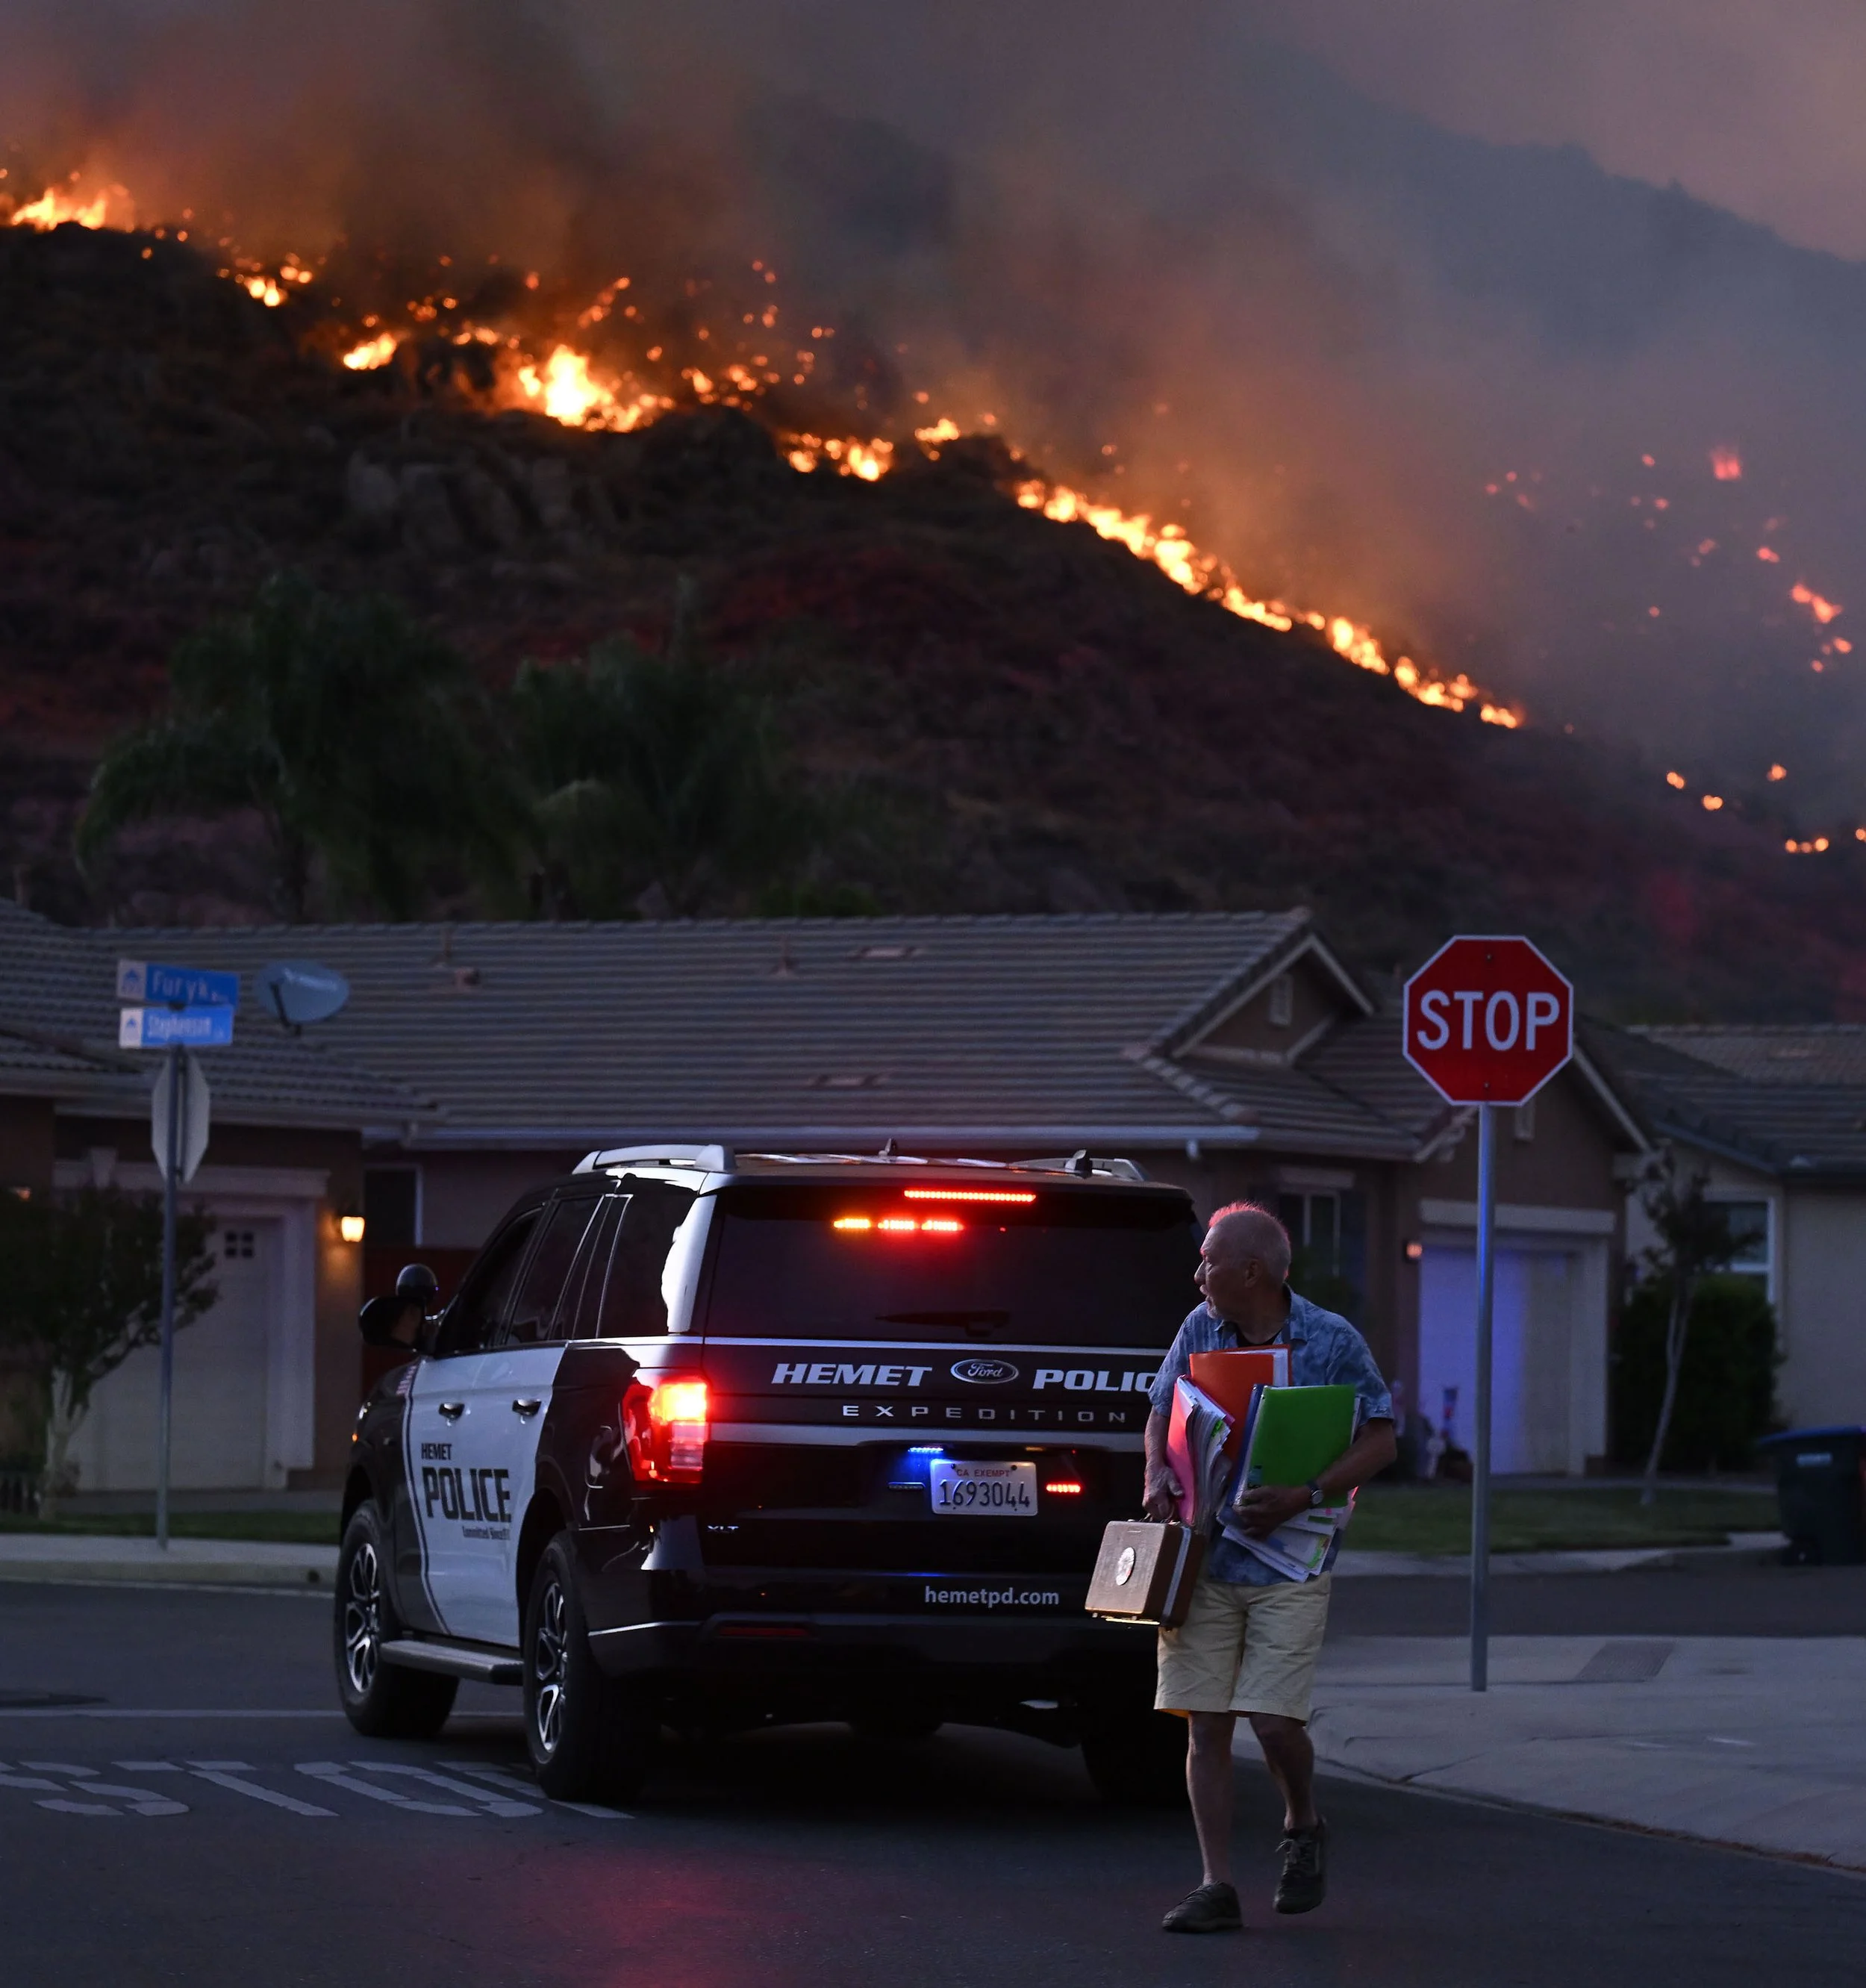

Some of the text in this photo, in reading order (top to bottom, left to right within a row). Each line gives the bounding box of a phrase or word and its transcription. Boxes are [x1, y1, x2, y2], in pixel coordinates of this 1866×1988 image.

[1417, 990, 1560, 1051] STOP
[771, 1363, 1158, 1392] HEMET POLIC
[967, 1362, 1003, 1377] Ford
[842, 1405, 1126, 1423] EXPEDITION
[421, 1442, 452, 1460] HEMET
[956, 1469, 1011, 1477] CA EXEMPT
[422, 1466, 512, 1523] POLICE
[939, 1479, 1030, 1508] 1693044
[924, 1586, 1059, 1609] hemetpd.com
